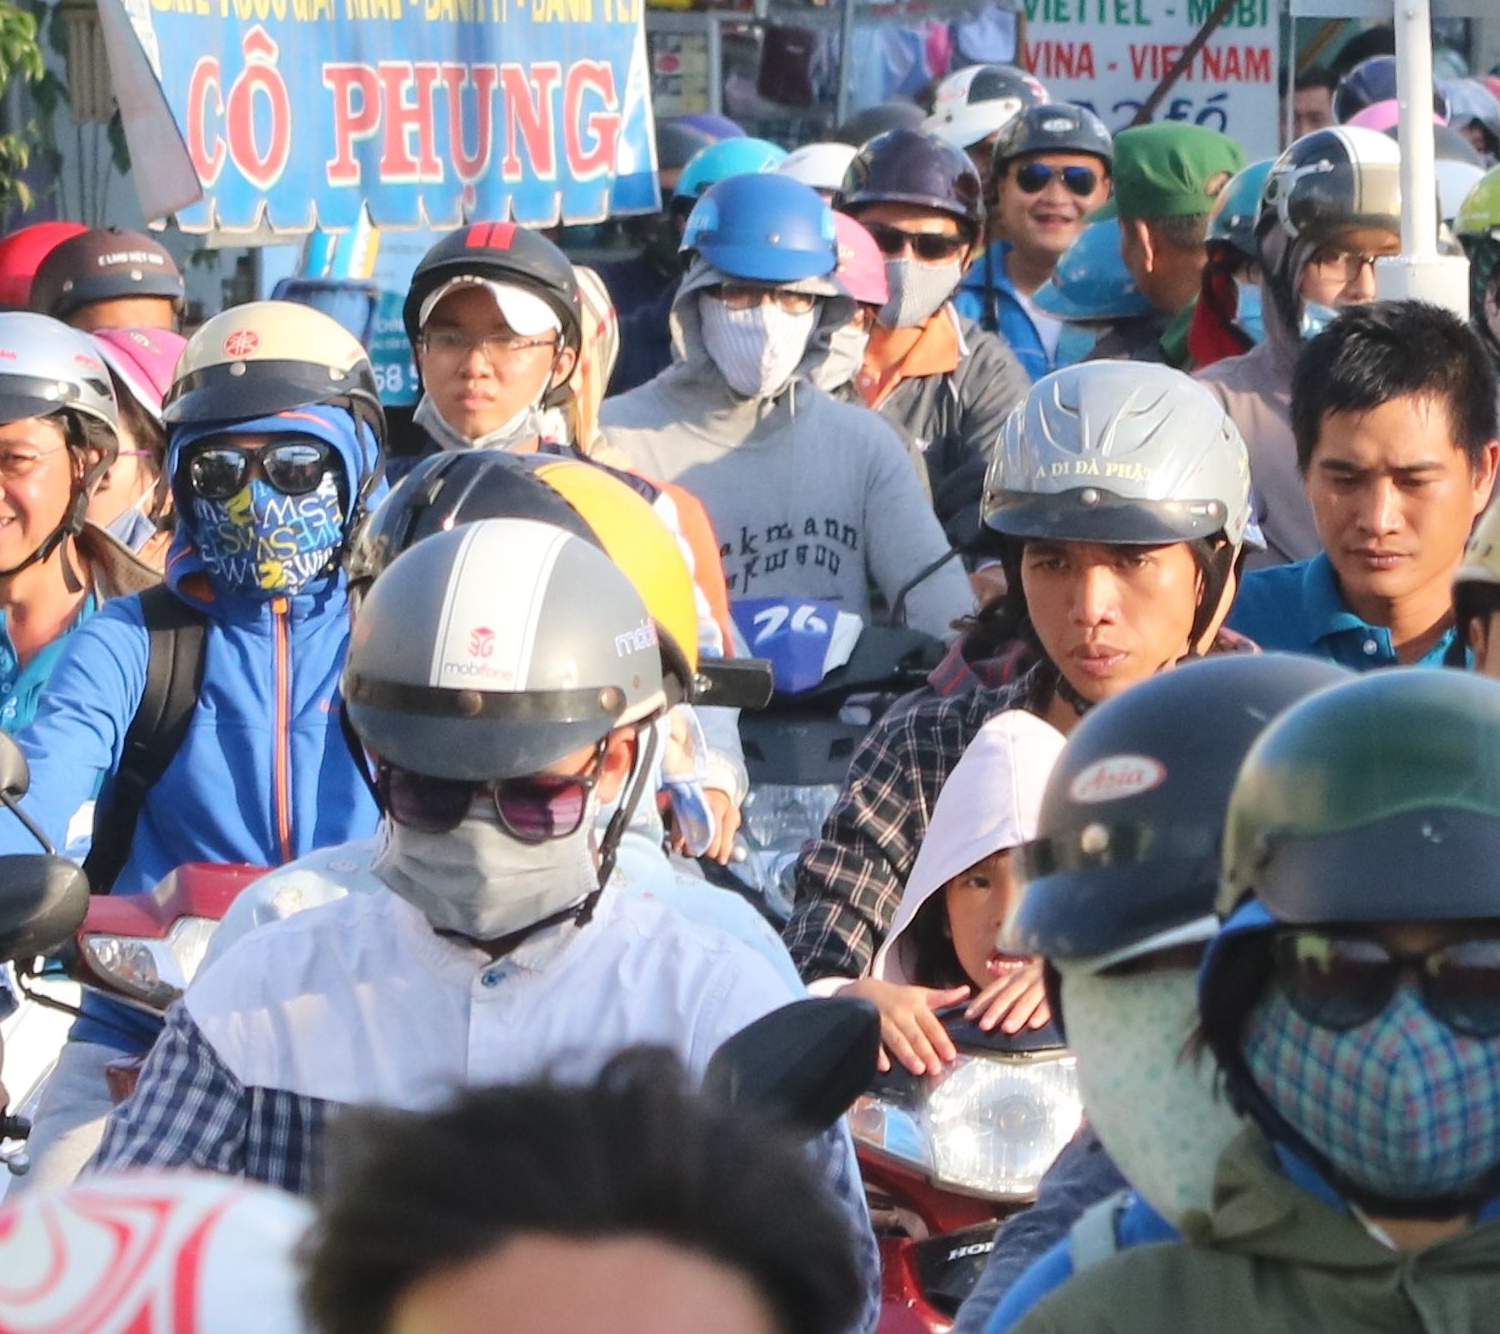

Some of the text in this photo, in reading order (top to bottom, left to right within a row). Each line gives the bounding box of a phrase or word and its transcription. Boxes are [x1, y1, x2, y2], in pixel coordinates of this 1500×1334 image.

[1024, 40, 1096, 80] VINA
[187, 24, 622, 210] CÔ PHỤNG
[443, 660, 515, 681] mobifone
